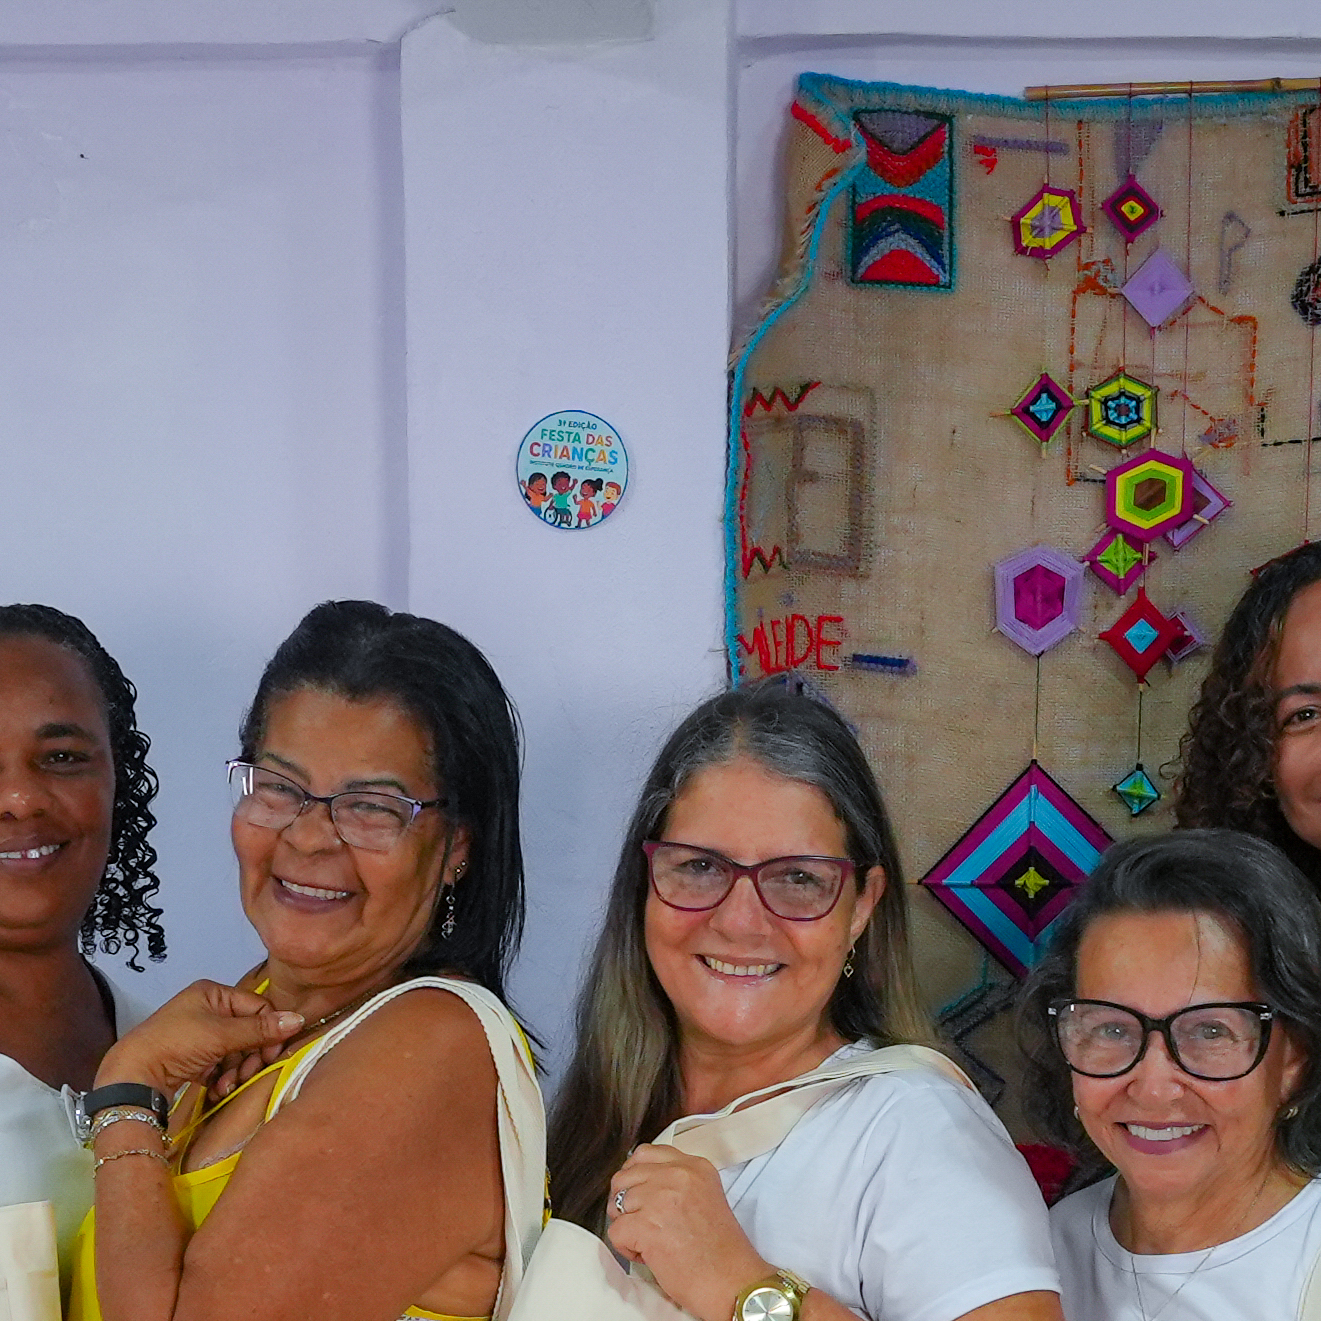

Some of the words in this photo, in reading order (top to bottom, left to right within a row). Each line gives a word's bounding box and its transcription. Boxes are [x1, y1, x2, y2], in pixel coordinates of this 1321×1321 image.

[568, 420, 598, 431] EDIÇÃO
[541, 429, 581, 444] FESTA
[586, 434, 612, 447] DAS
[530, 442, 618, 465] CRIANÇAS
